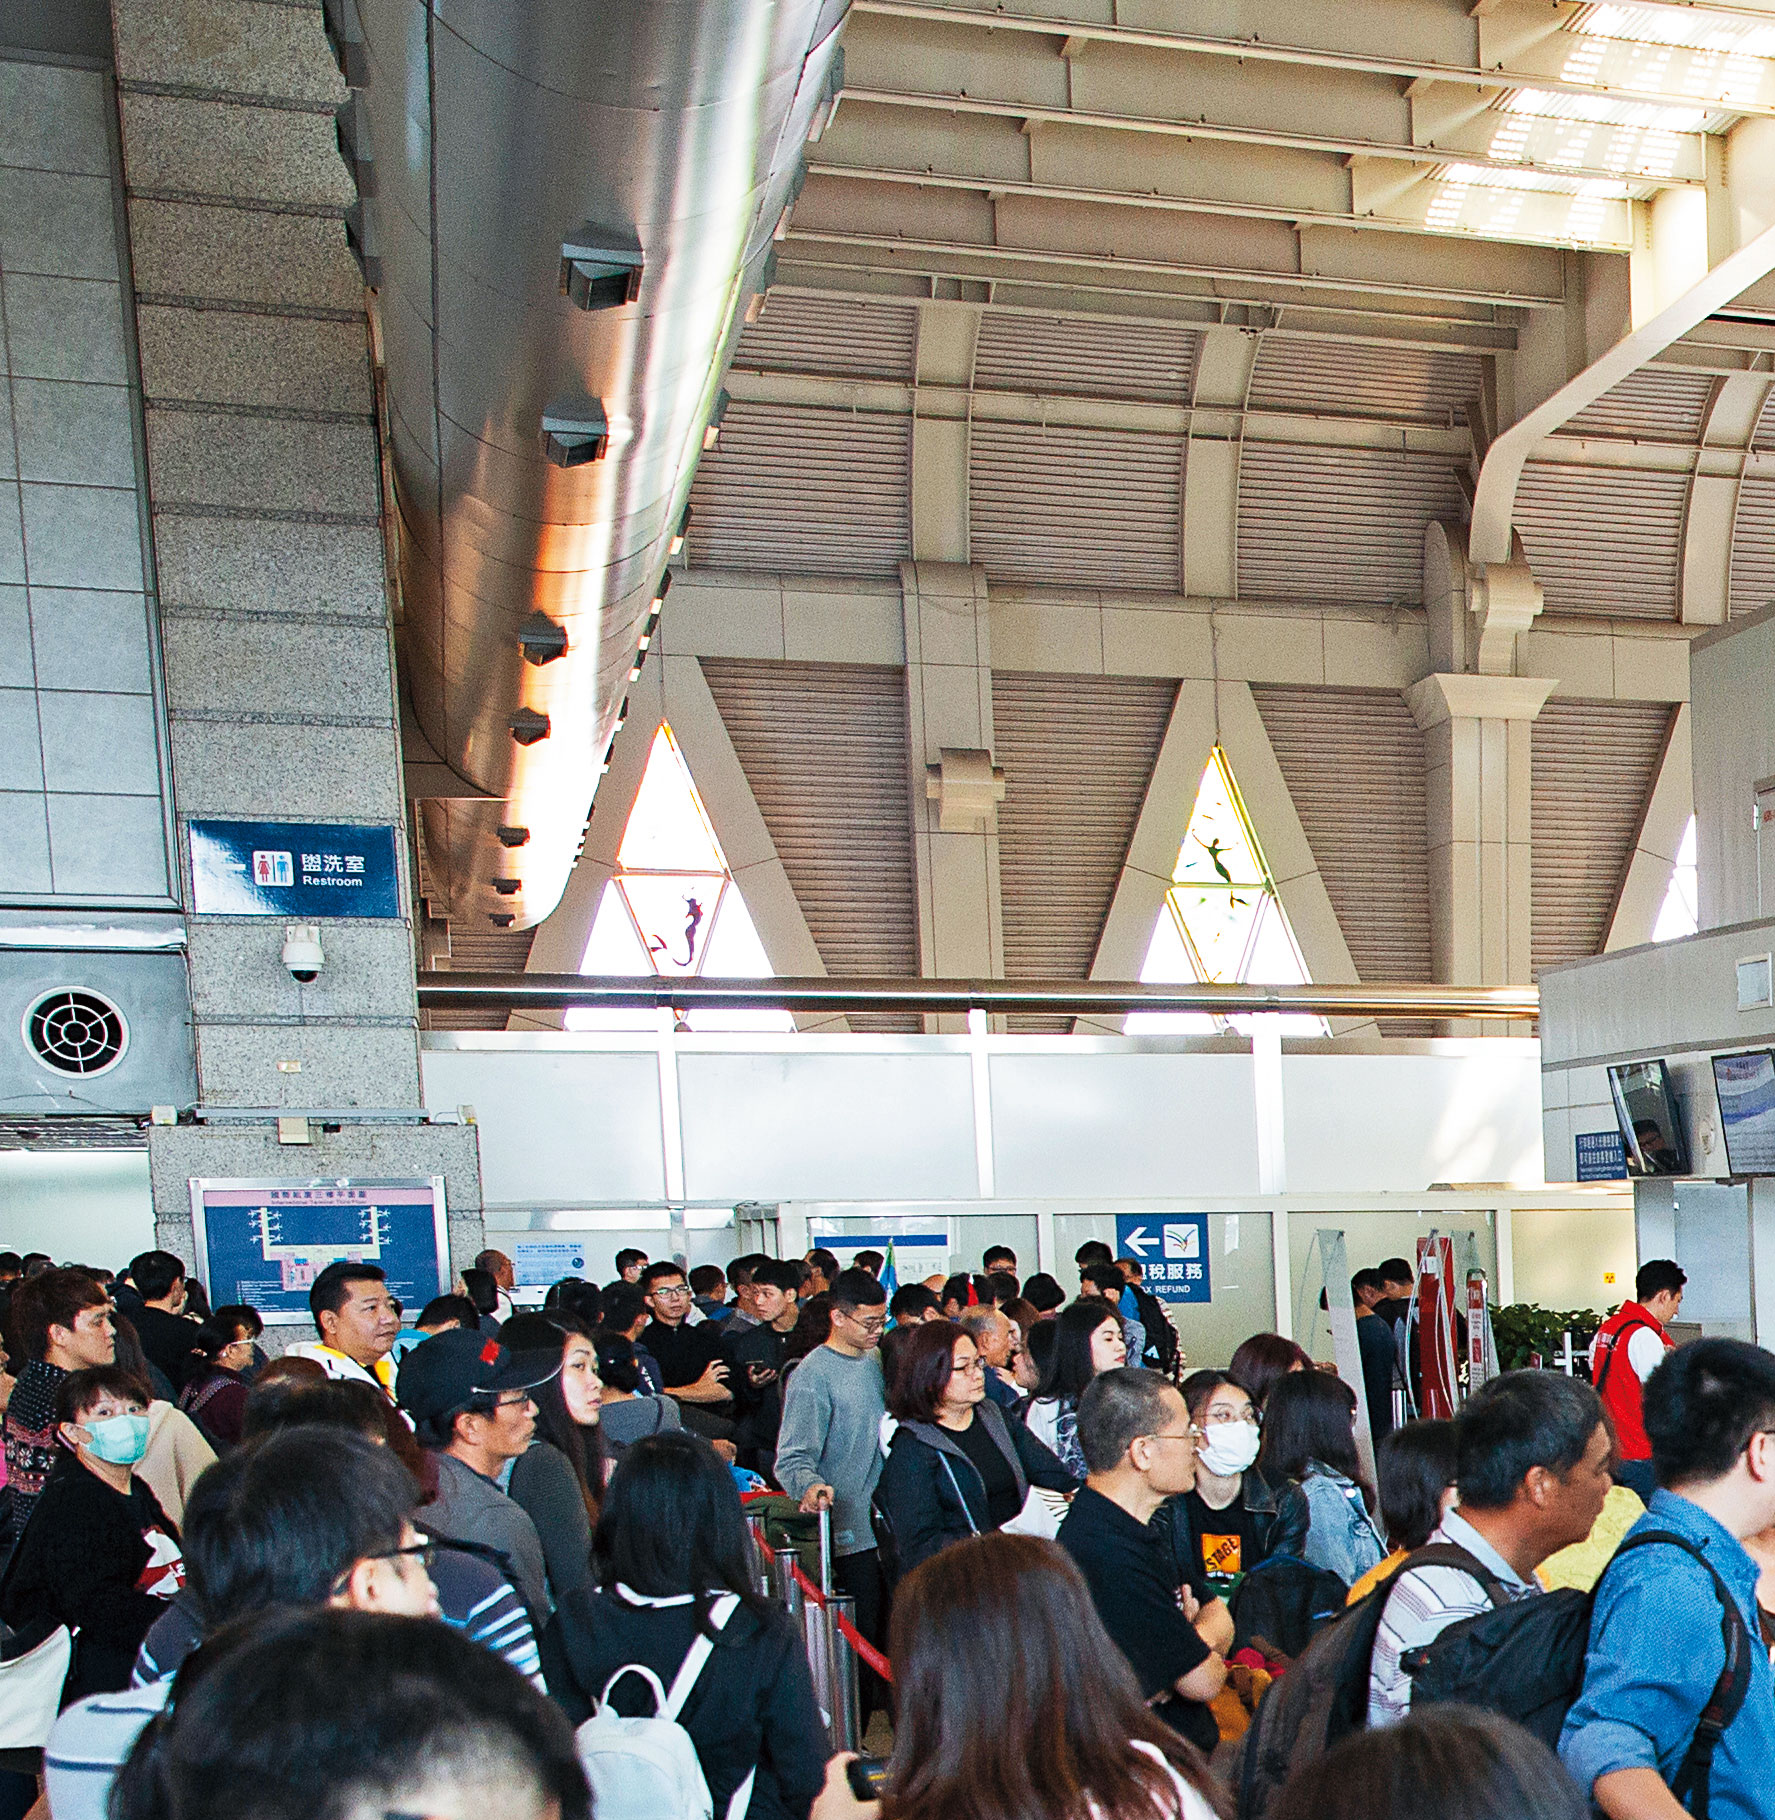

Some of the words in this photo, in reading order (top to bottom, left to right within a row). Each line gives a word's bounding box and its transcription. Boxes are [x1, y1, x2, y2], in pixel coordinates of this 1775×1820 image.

[301, 854, 365, 873] 盥洗室
[303, 876, 362, 887] Restroom
[1142, 1263, 1203, 1280] 稅服務
[1155, 1285, 1191, 1293] REFUND
